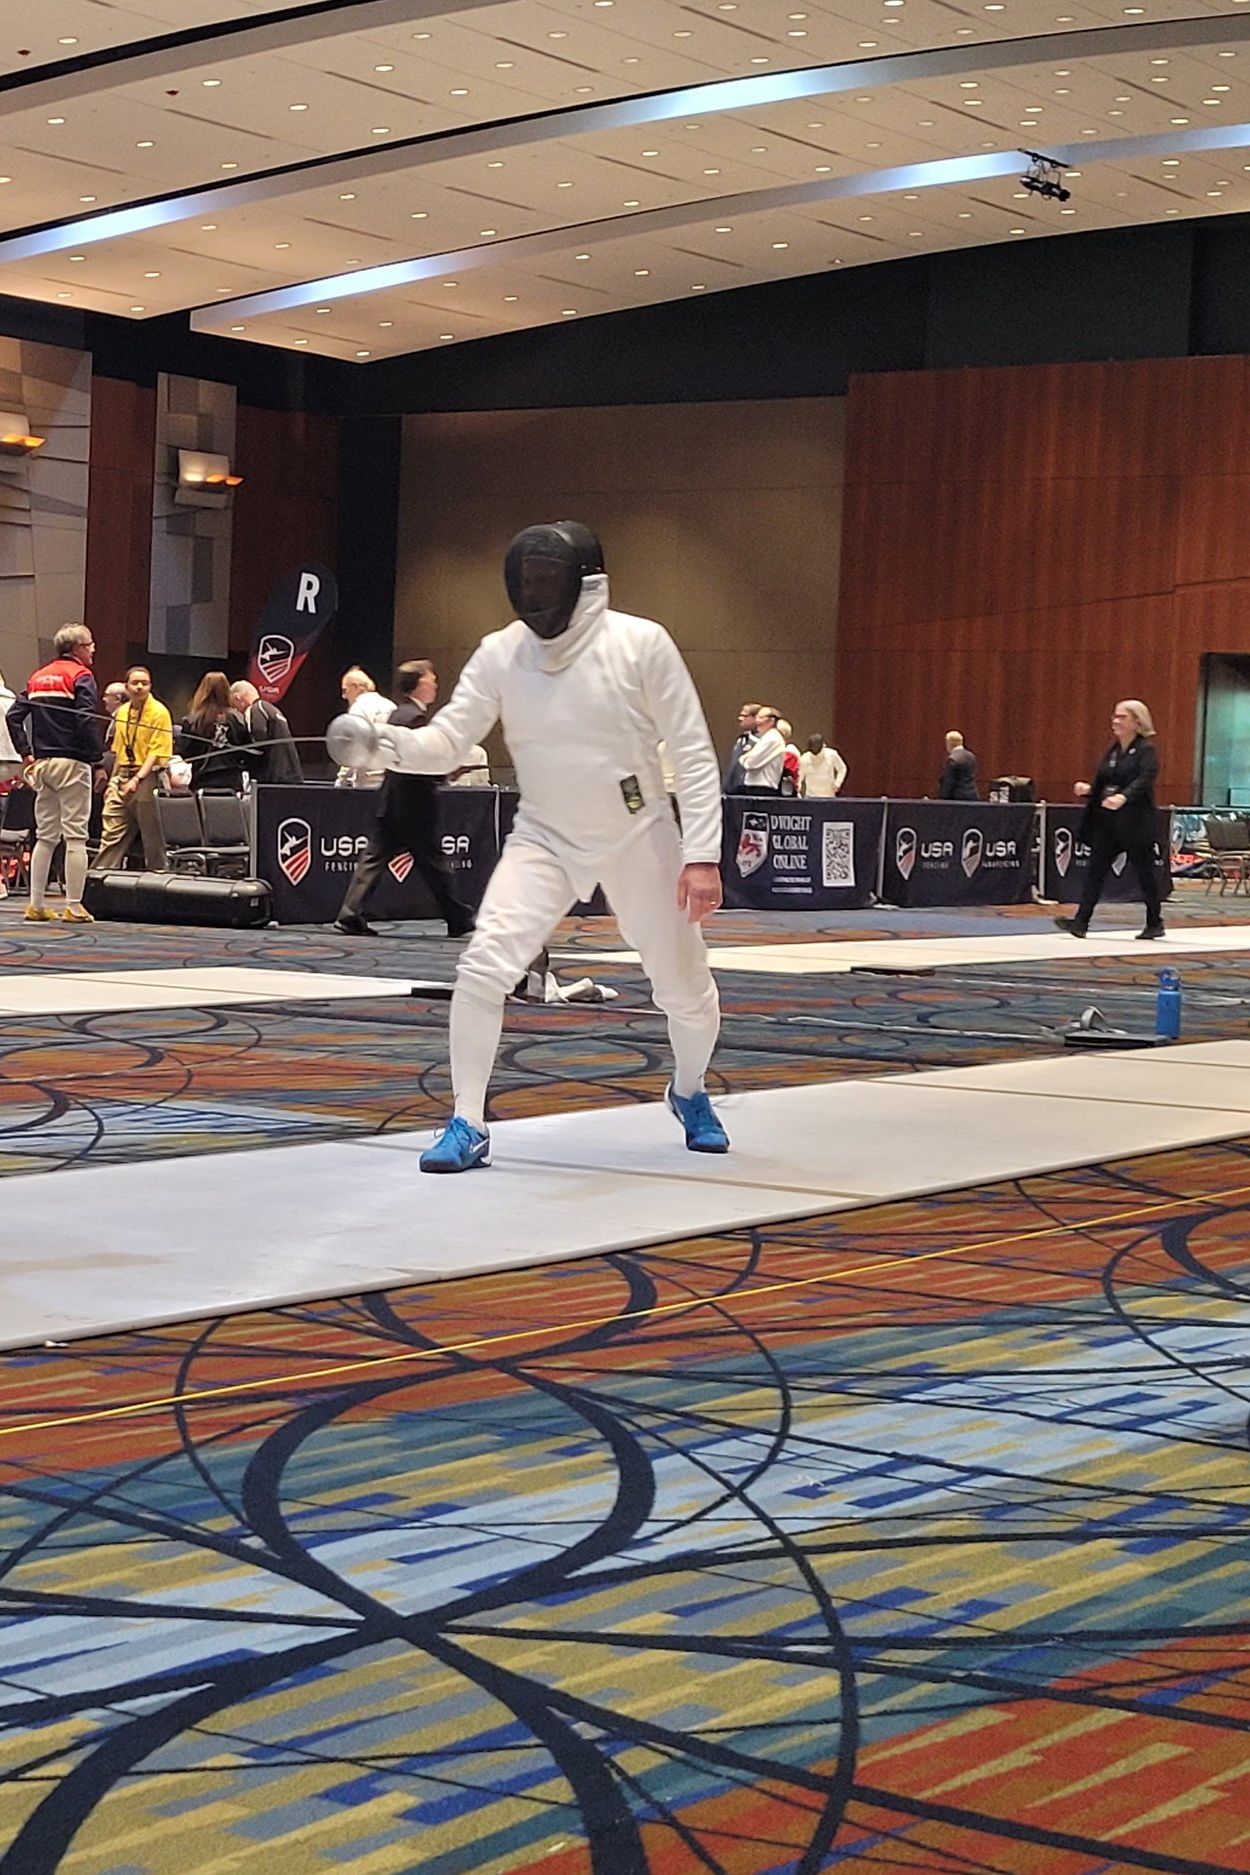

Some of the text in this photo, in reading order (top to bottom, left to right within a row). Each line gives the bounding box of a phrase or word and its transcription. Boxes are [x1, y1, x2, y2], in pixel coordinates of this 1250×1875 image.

[296, 571, 321, 614] R
[770, 815, 813, 831] DWIGHT
[441, 835, 471, 855] SA
[772, 834, 809, 851] GLOBAL
[921, 841, 954, 858] USA
[985, 840, 1017, 857] USA
[773, 854, 808, 870] ONLINE
